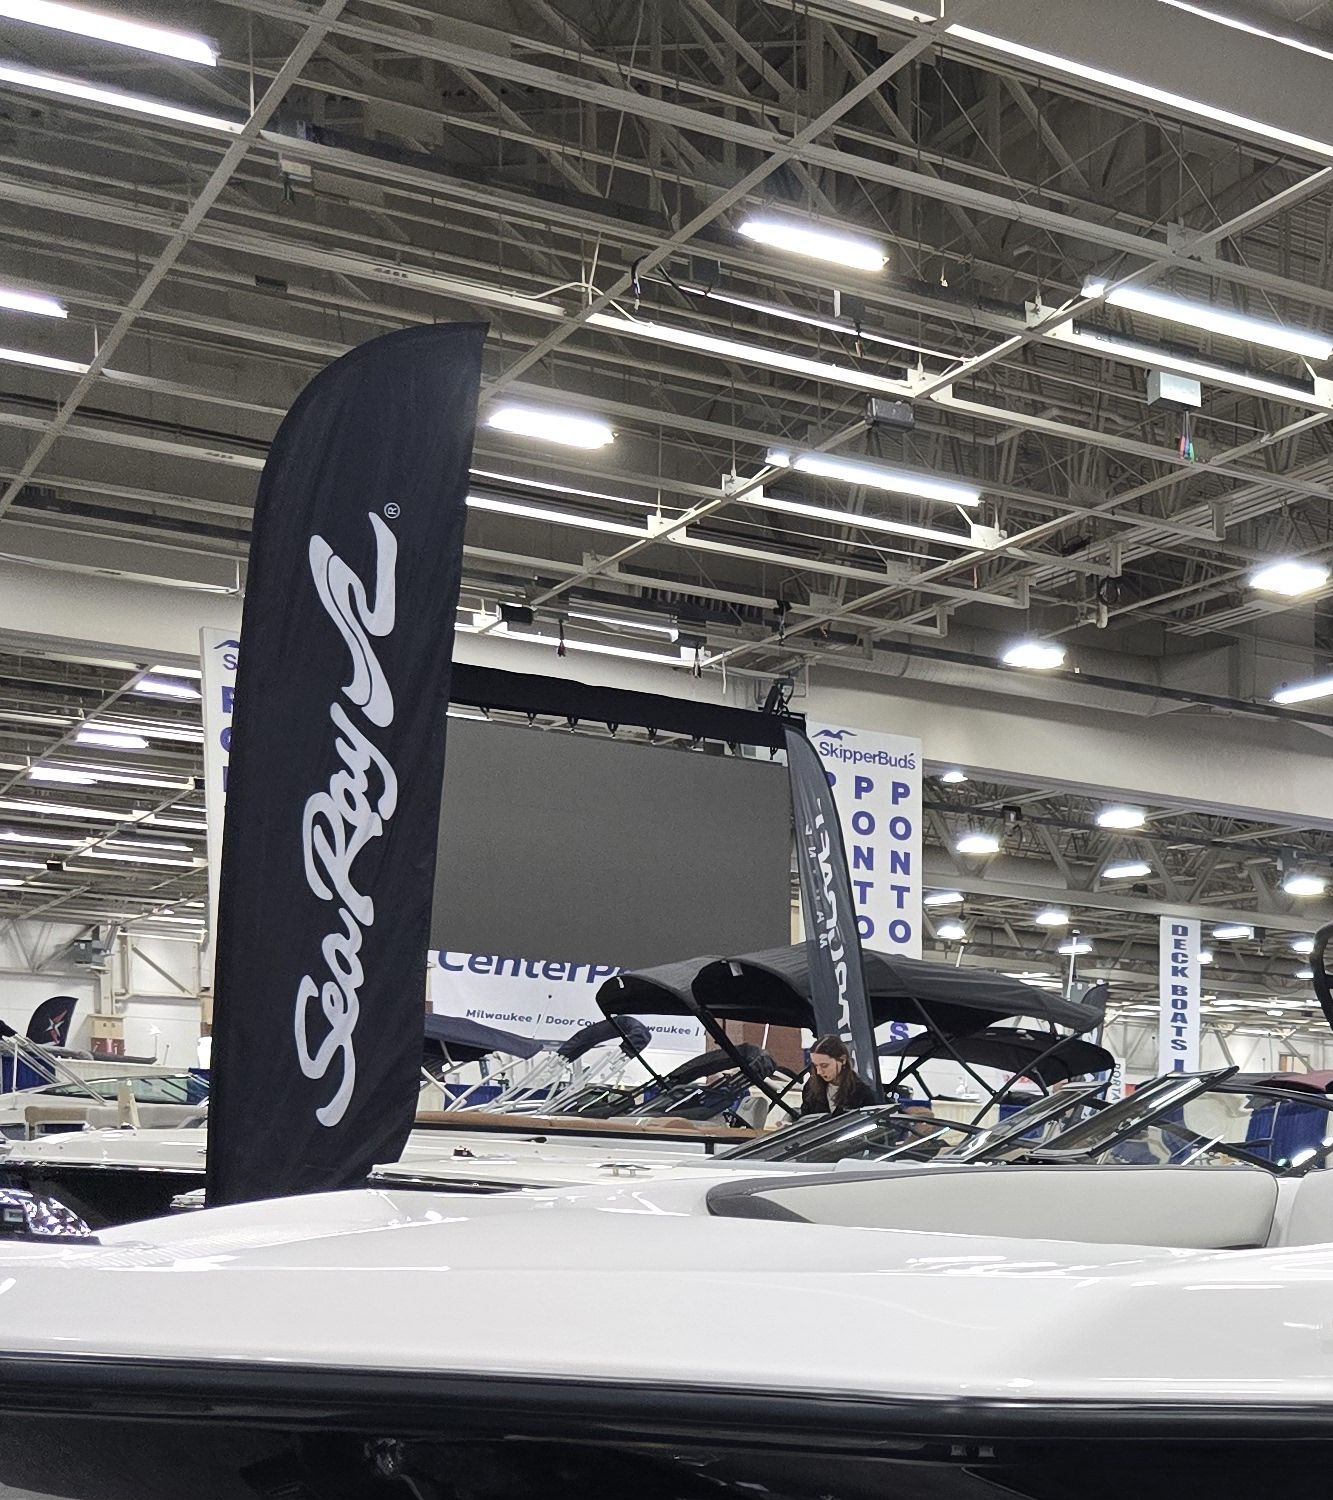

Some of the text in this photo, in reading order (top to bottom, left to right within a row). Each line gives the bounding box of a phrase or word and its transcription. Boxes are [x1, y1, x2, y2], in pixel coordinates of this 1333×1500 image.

[437, 950, 634, 984] CenterP
[1170, 924, 1190, 1052] DECK BOATS
[465, 1008, 533, 1024] Milwaukee
[544, 1015, 576, 1027] Door
